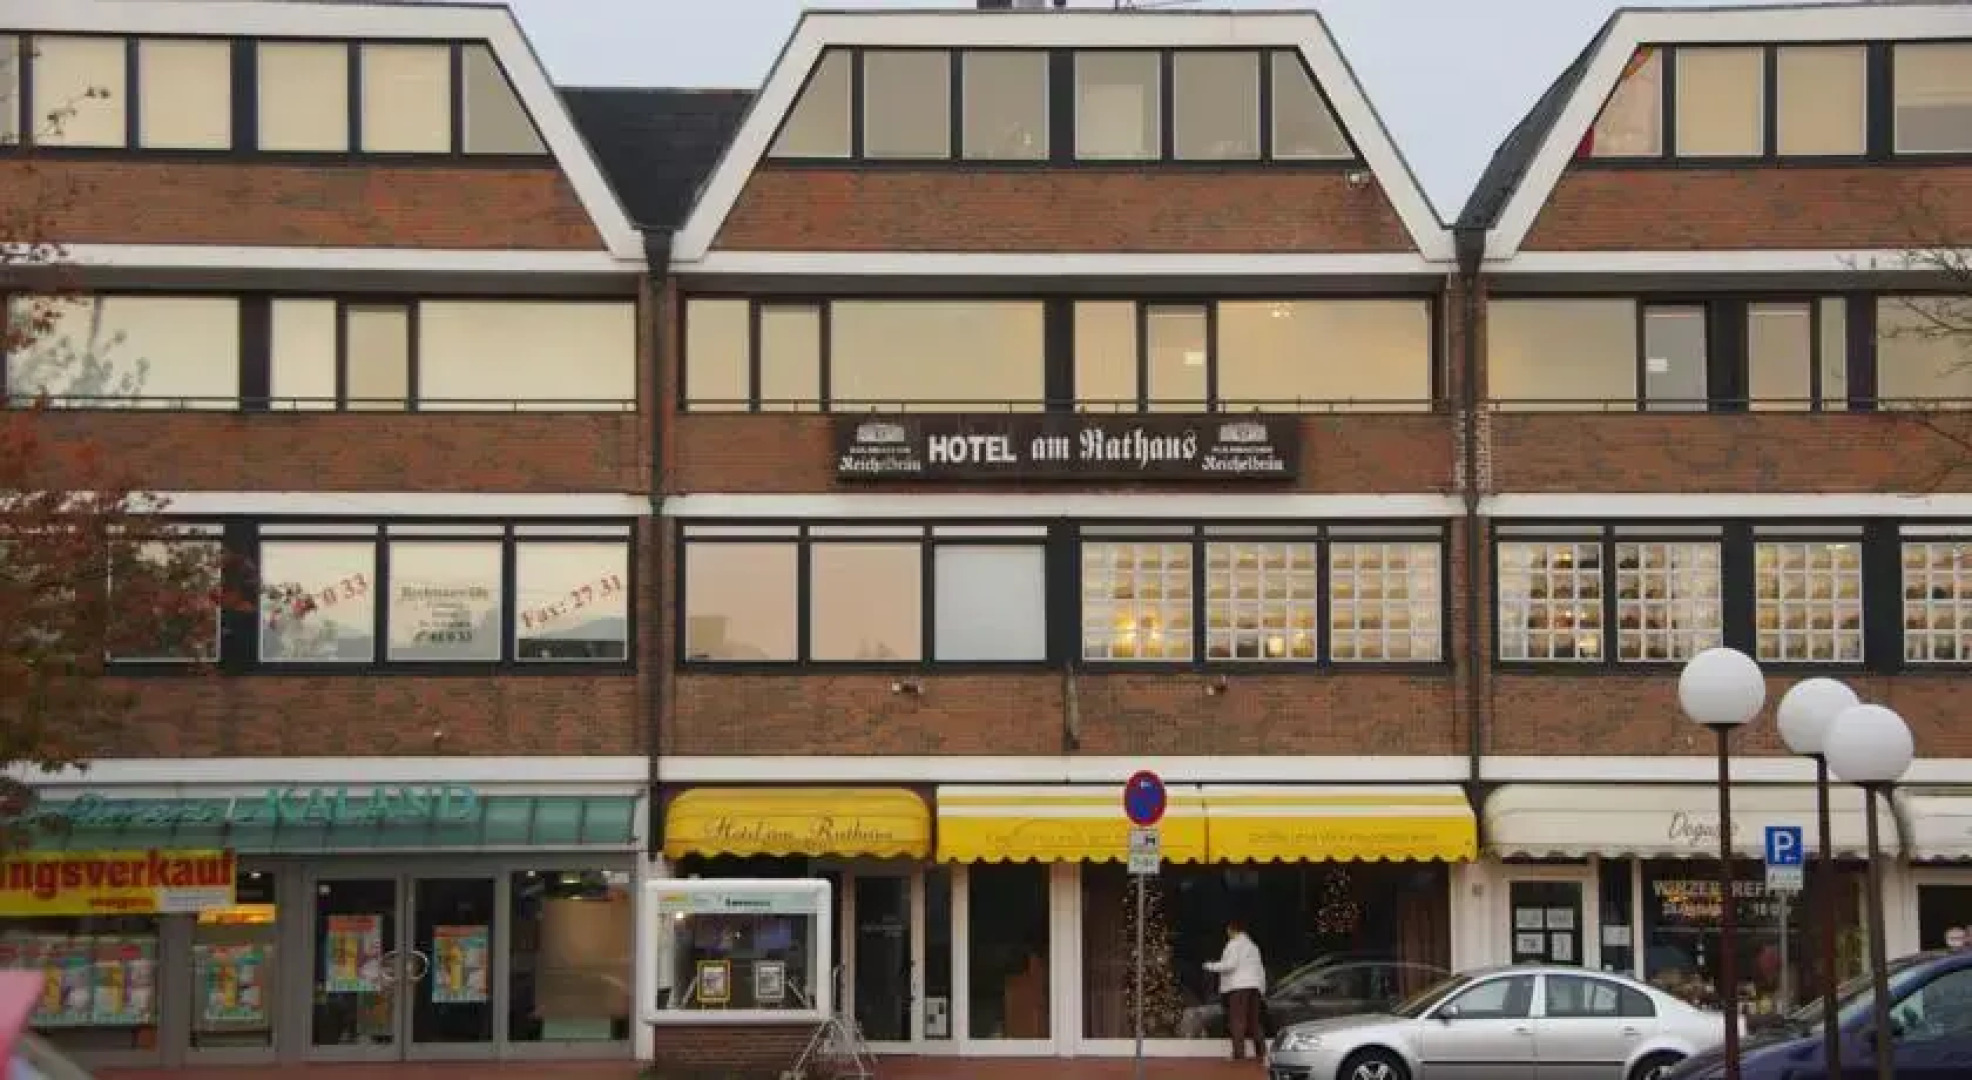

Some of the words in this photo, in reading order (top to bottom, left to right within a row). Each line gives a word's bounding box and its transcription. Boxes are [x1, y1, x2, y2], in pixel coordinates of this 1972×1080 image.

[927, 433, 1016, 464] HOTEL
[1031, 433, 1069, 460] am
[1079, 425, 1197, 471] Rathaus
[265, 784, 478, 822] KALAND
[1773, 831, 1793, 863] P
